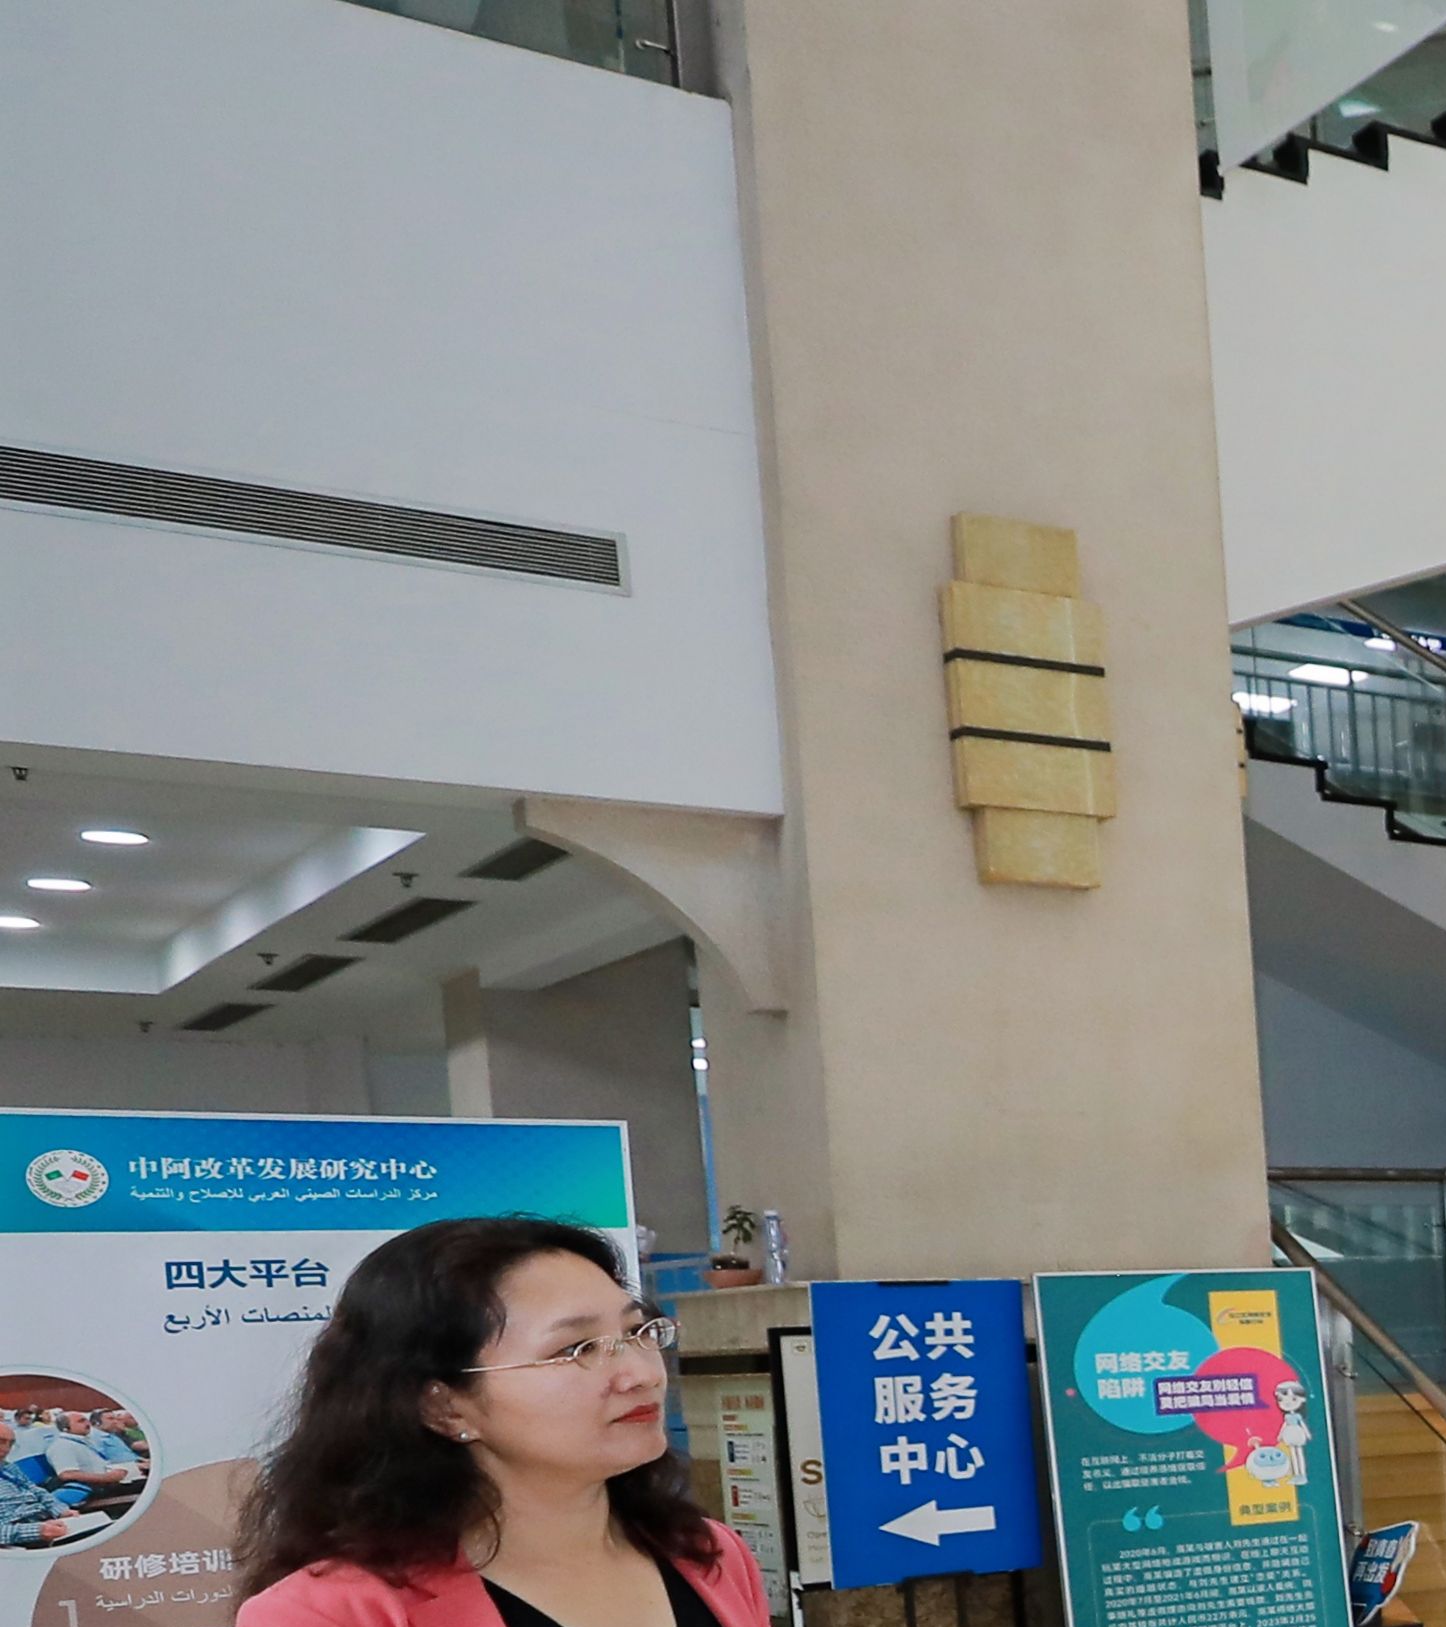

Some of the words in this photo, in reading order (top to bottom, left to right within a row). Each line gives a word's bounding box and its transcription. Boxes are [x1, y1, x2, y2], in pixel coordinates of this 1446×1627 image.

[128, 1156, 438, 1181] 中阿改革发展研究中心
[248, 1187, 289, 1202] العربي
[295, 1187, 340, 1202] الصيني
[346, 1187, 401, 1200] الدراسات
[407, 1188, 438, 1201] مركز
[164, 1258, 331, 1290] 四大平台
[163, 1307, 230, 1333] الأربع
[869, 1311, 975, 1362] 公共
[1095, 1350, 1190, 1374] 网络交友
[1097, 1377, 1146, 1399] 陷阱
[1157, 1378, 1254, 1394] 网络交友别轻信
[873, 1373, 978, 1424] 服务
[880, 1434, 985, 1485] 中心
[100, 1549, 232, 1581] 研修培训
